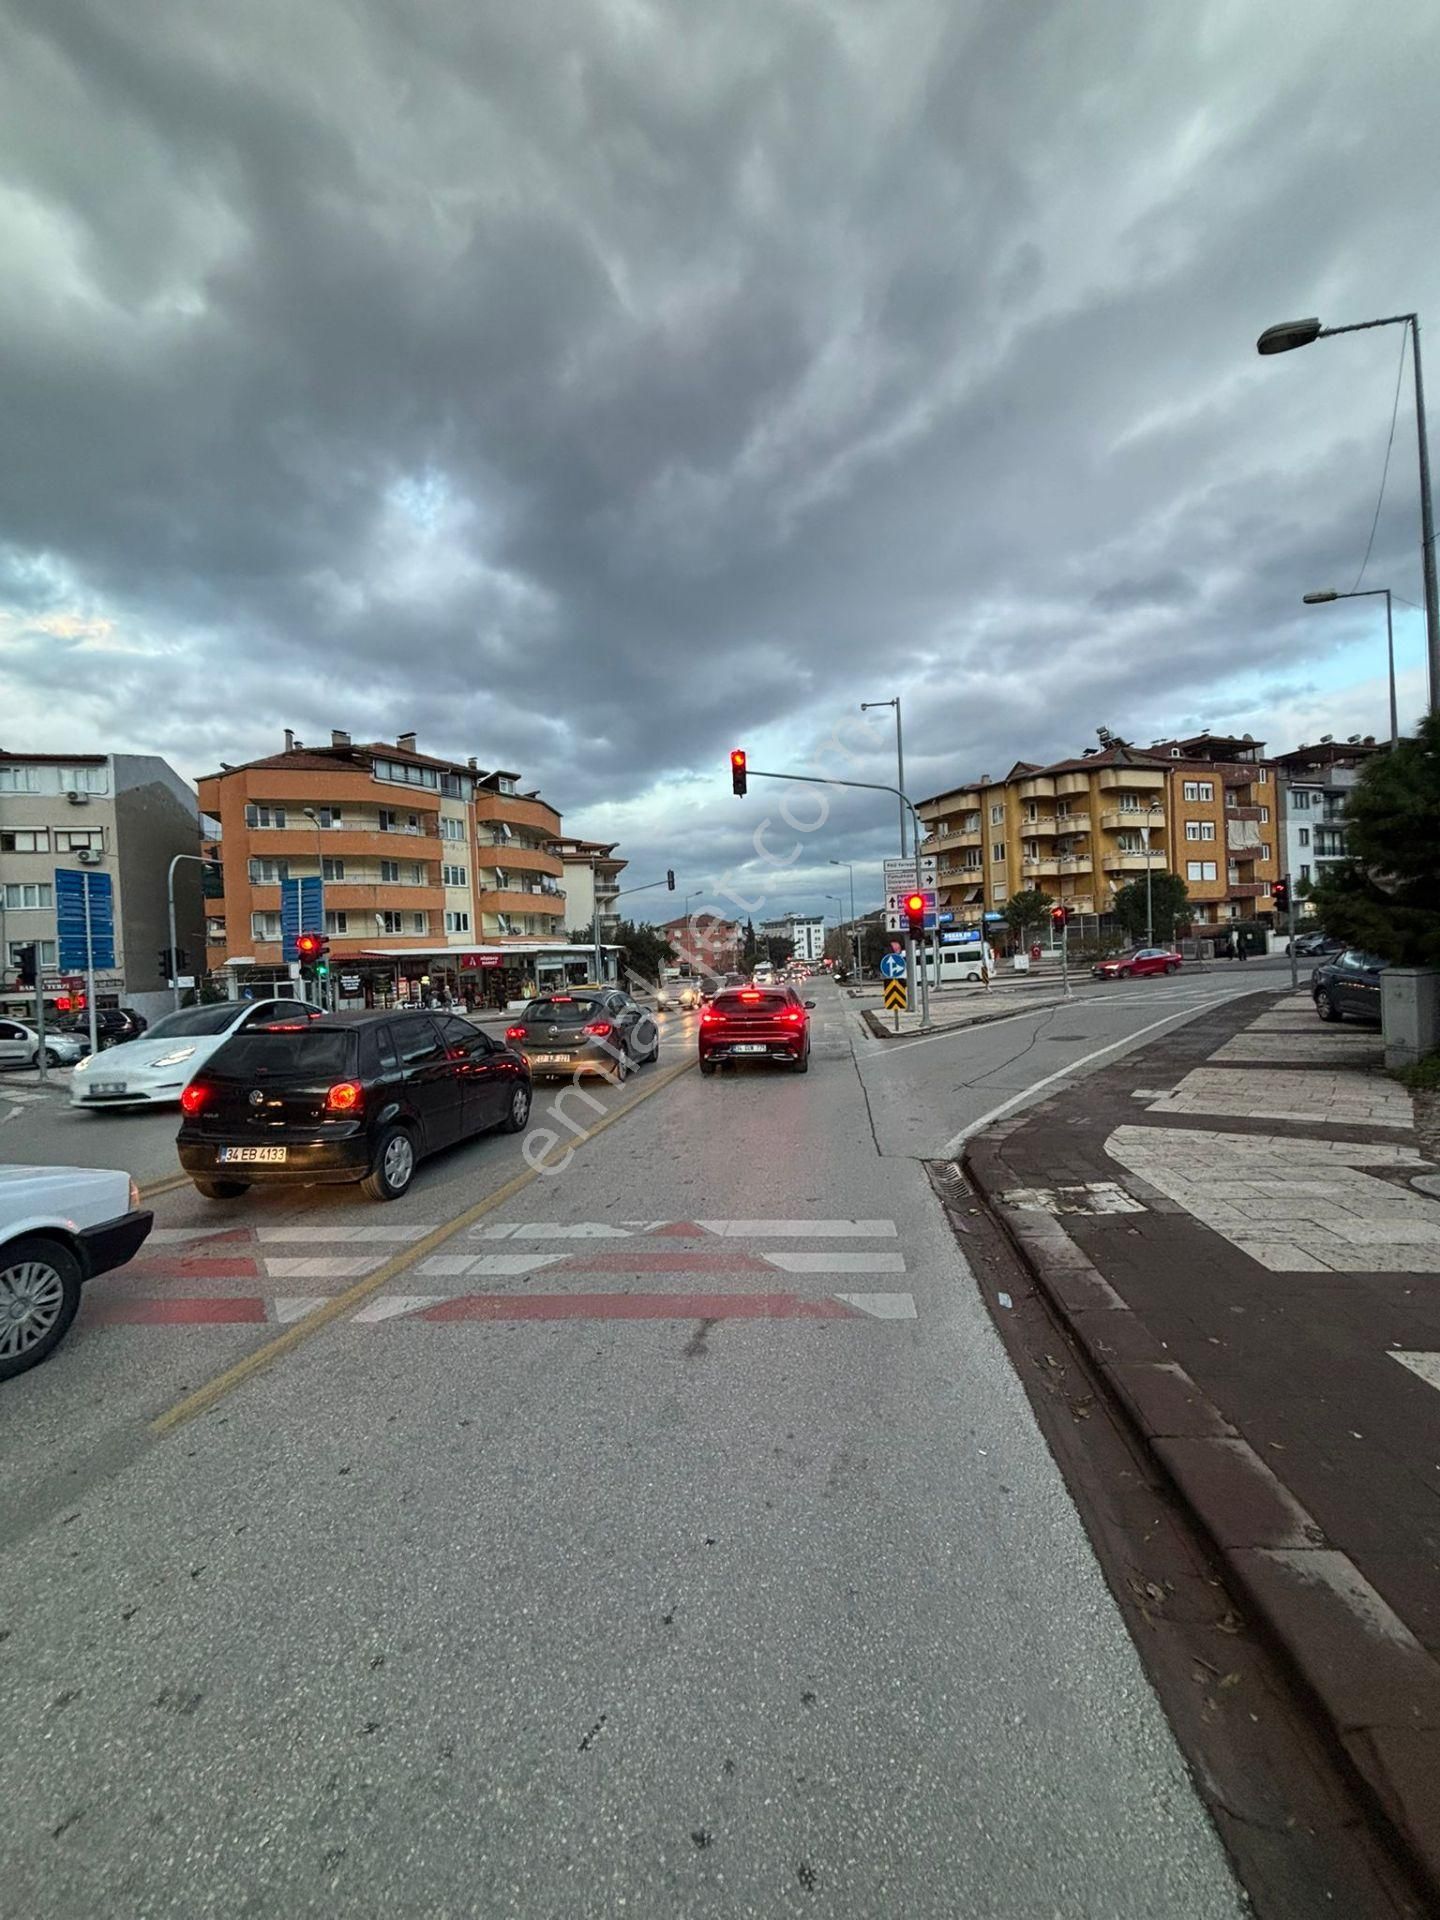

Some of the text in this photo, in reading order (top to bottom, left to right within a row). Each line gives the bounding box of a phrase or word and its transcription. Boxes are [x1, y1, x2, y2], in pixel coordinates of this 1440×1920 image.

[226, 1148, 285, 1161] 34 EB 4133
